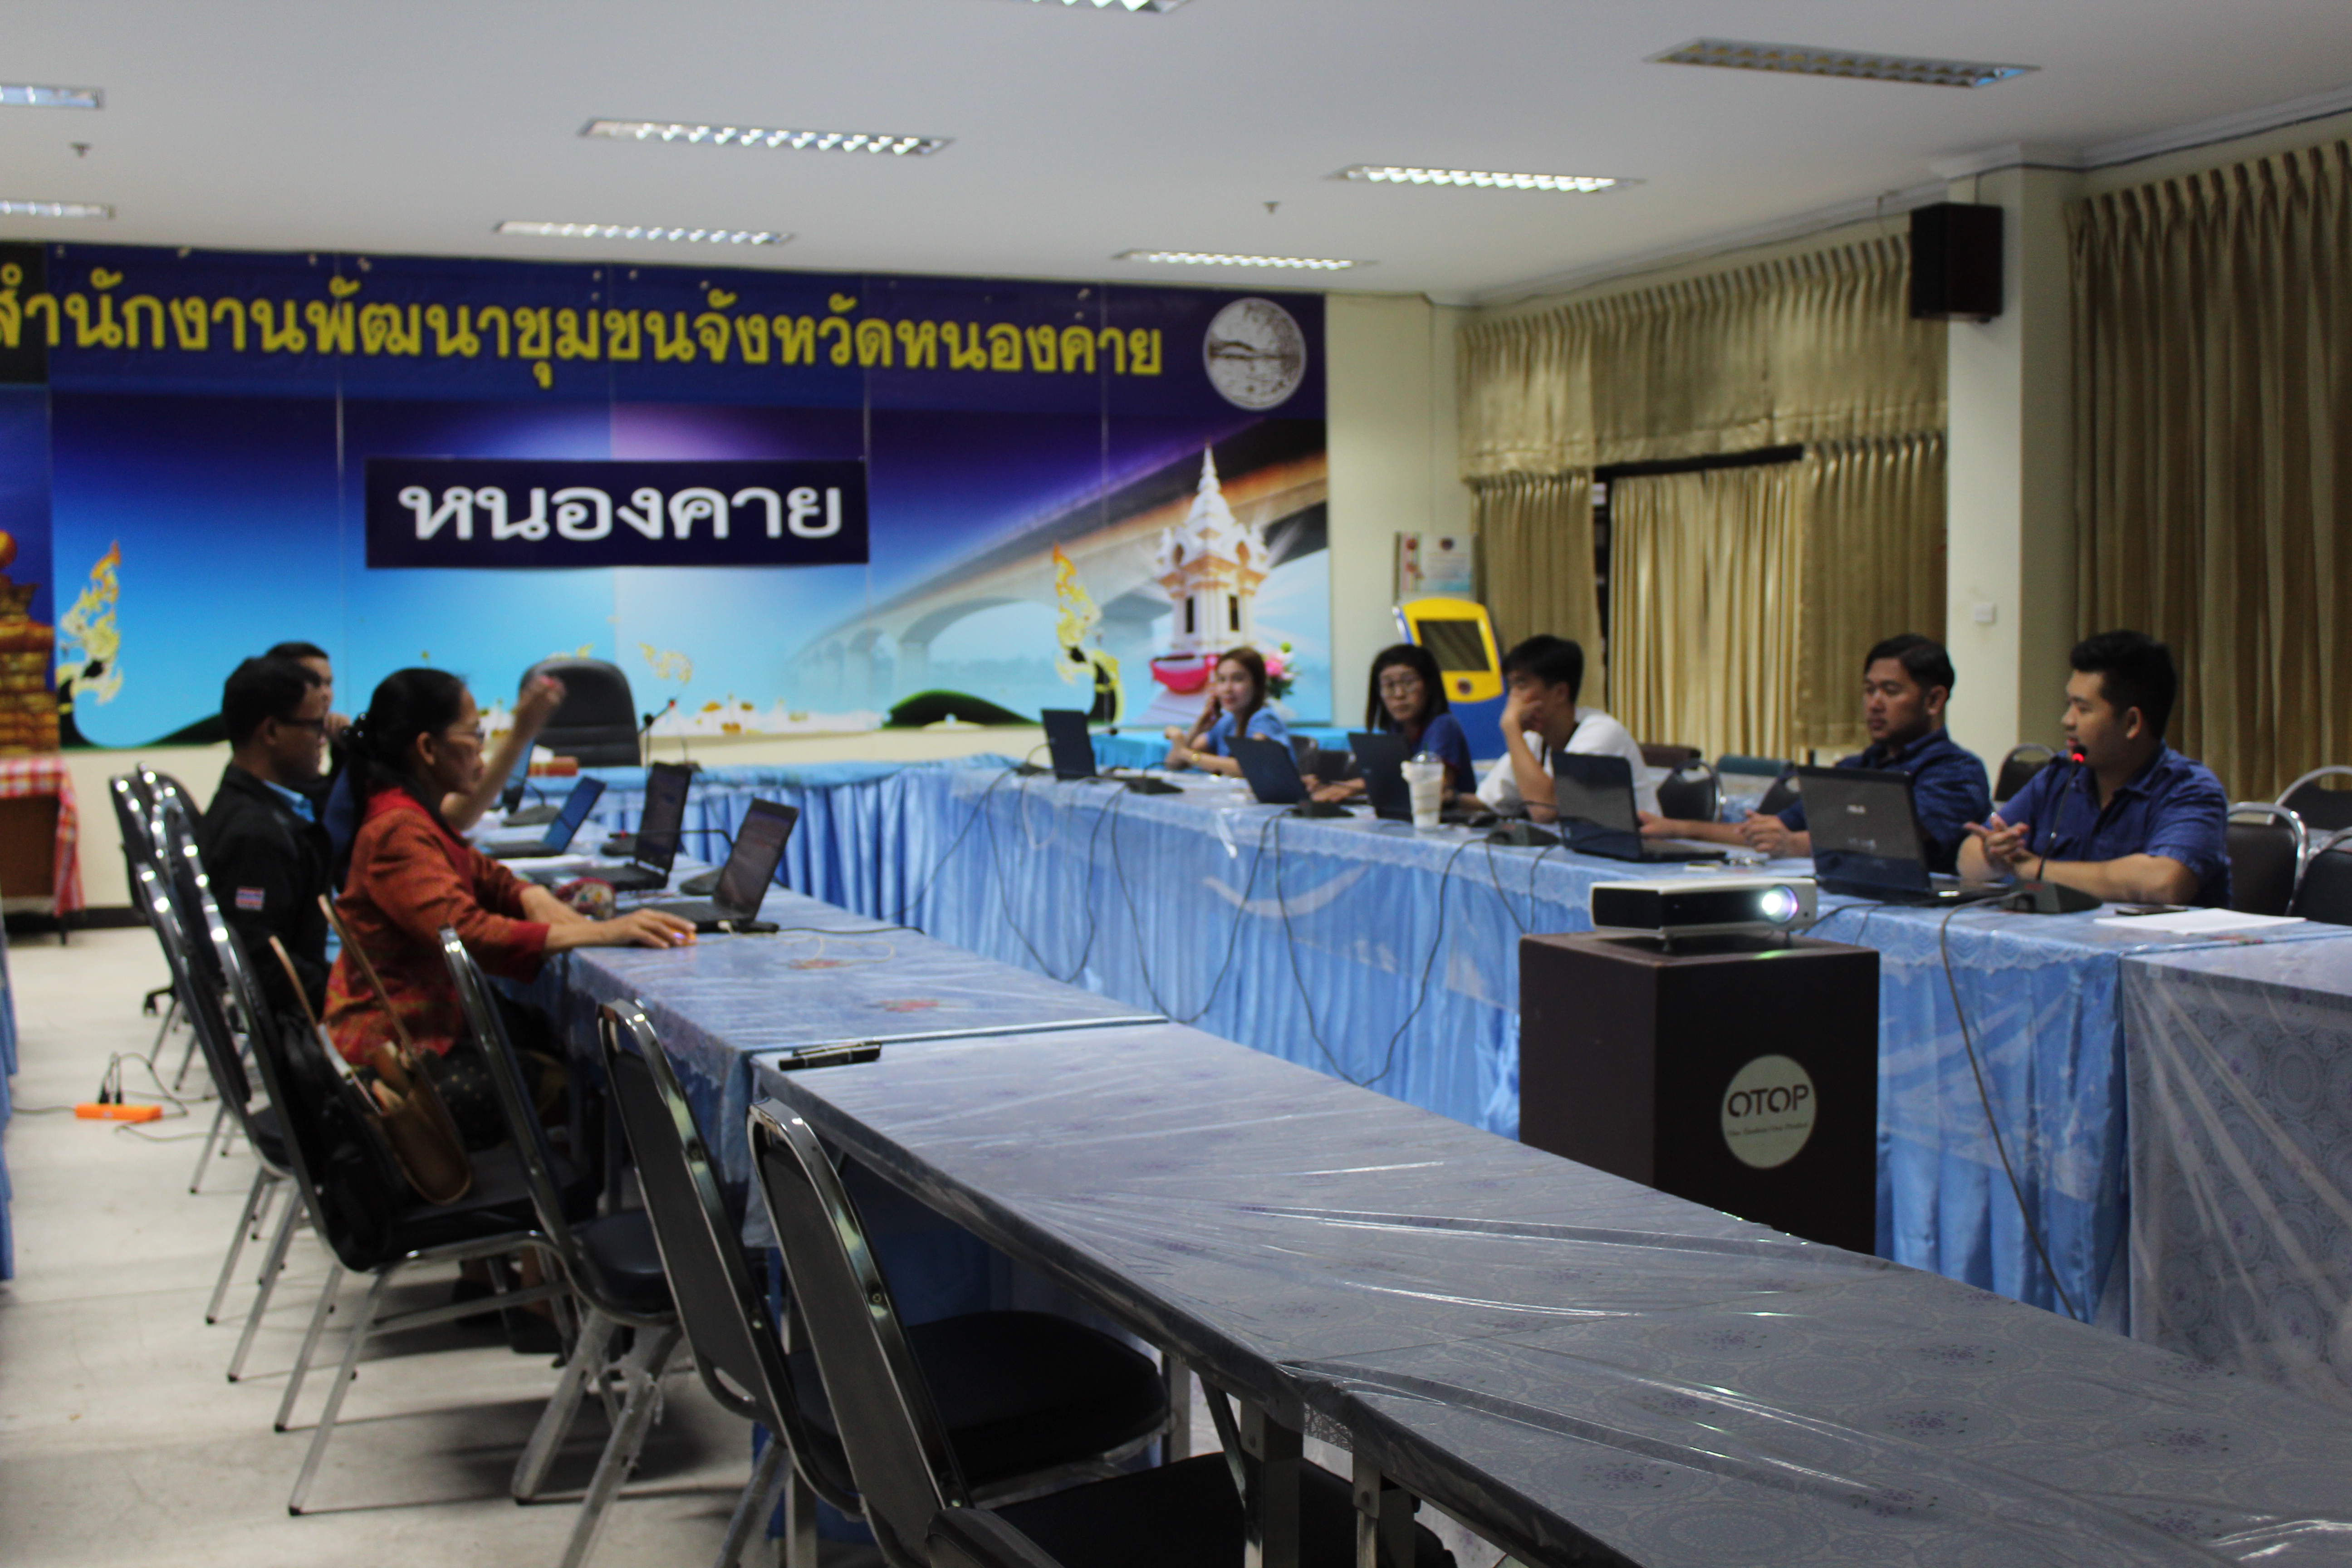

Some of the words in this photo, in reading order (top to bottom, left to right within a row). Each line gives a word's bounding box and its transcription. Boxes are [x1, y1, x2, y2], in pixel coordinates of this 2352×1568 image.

[398, 485, 842, 540] หนองคาย
[1727, 1083, 1809, 1117] OTOP
